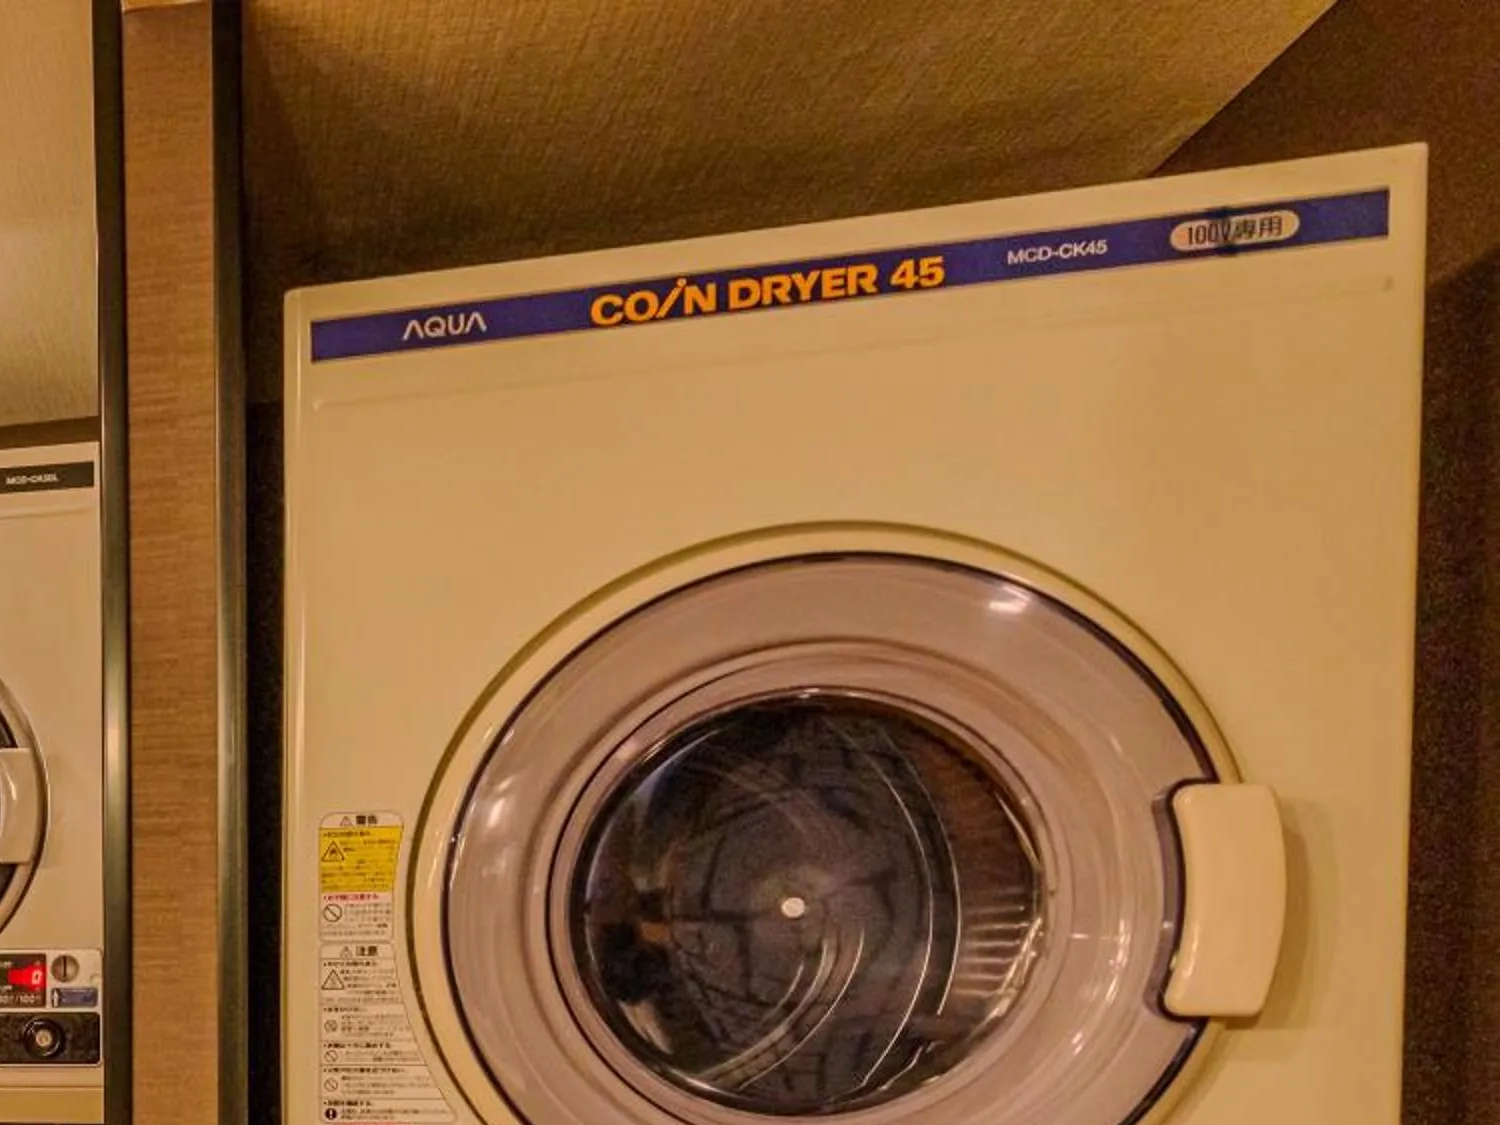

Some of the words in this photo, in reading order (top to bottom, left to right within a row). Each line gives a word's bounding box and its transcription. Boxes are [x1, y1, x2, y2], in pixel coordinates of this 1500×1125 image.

[1006, 239, 1108, 266] MCD-CK45
[728, 263, 879, 310] DRYER
[891, 255, 945, 289] 45
[403, 311, 488, 341] AQUA
